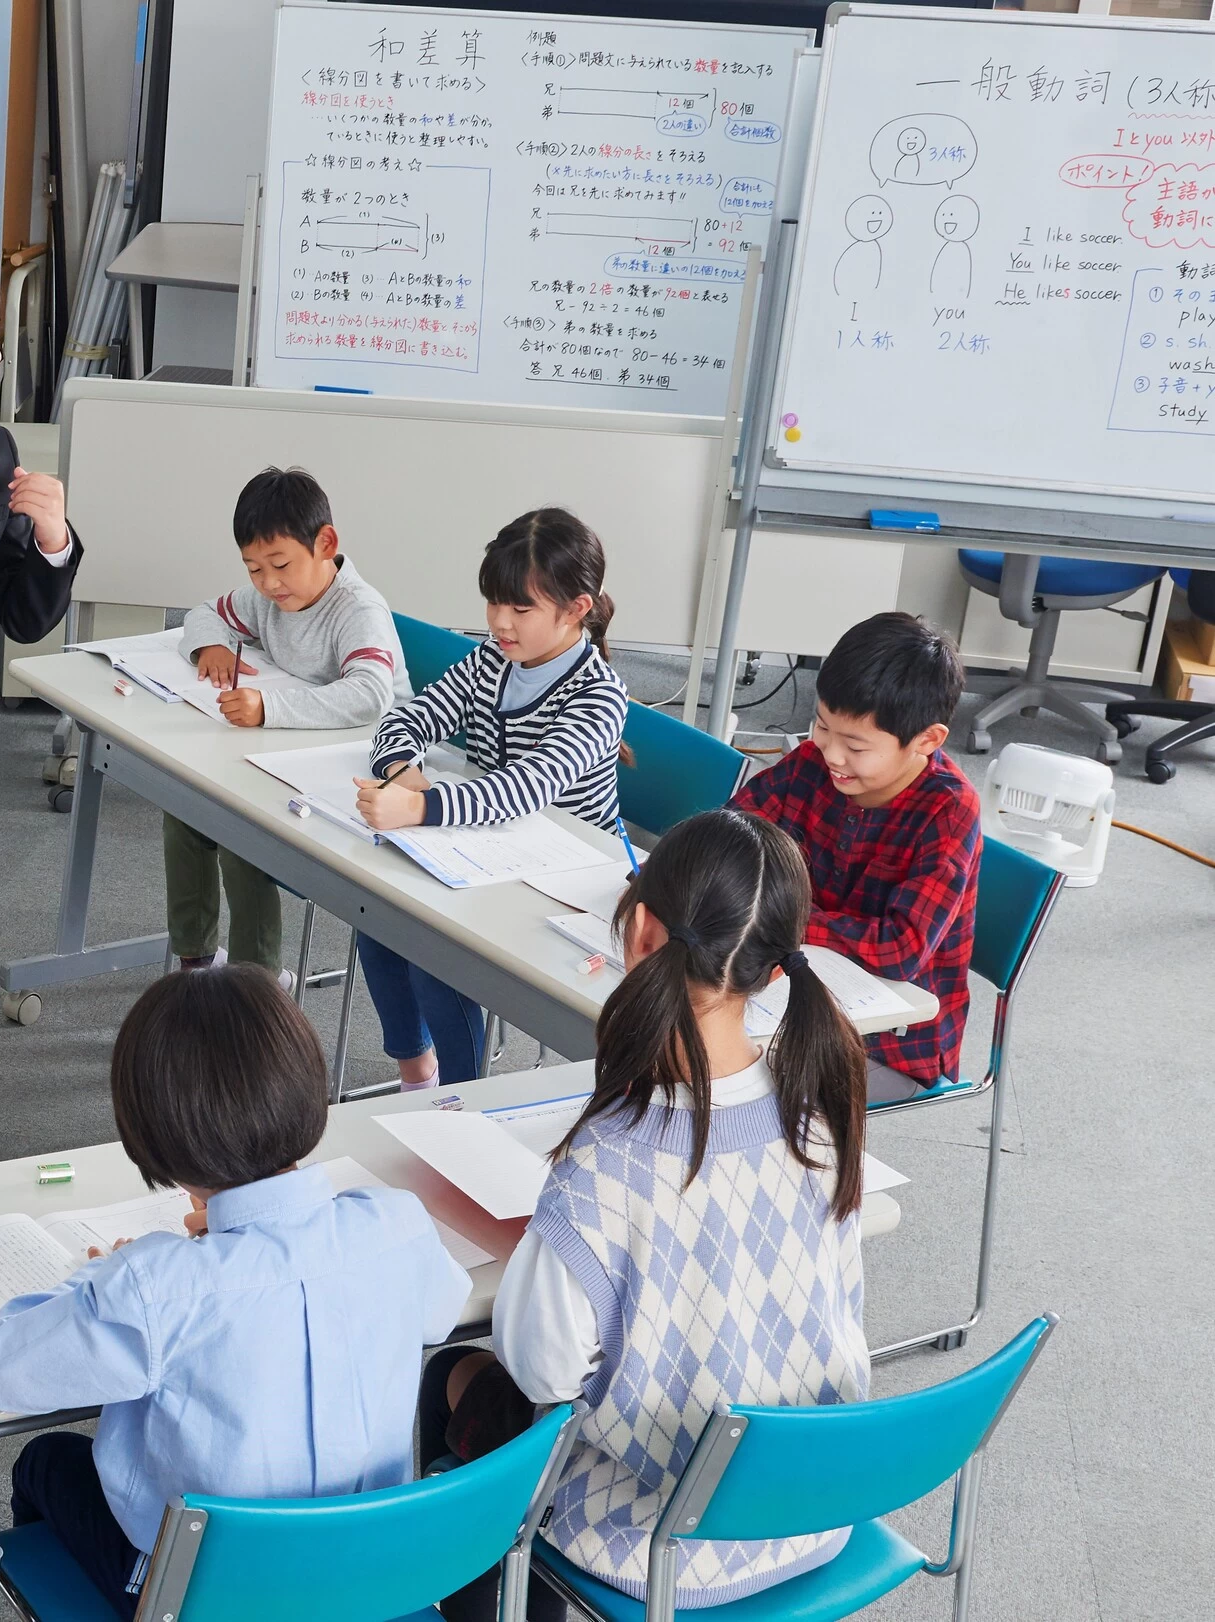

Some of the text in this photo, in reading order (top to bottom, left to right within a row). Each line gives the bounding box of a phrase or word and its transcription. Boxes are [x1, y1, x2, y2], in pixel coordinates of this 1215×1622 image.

[526, 29, 557, 45] 例題
[368, 27, 486, 70] 和差算
[544, 82, 557, 96] 兄
[301, 91, 394, 110] 線分図を使うとき
[541, 104, 554, 118] 弟
[928, 145, 968, 163] 3人称
[301, 188, 410, 207] 数量が2つのとき
[299, 215, 311, 228] A
[529, 207, 542, 219] 兄
[430, 233, 446, 244] (3)
[528, 227, 541, 241] 弟
[1022, 226, 1031, 242] I
[1046, 227, 1073, 242] like
[300, 239, 310, 253] B
[1009, 251, 1032, 271] You
[1042, 254, 1071, 271] like
[1003, 283, 1027, 300] He
[1035, 285, 1071, 301] likes
[848, 300, 859, 322] I
[932, 304, 966, 328] you
[836, 329, 895, 350] 1人称
[937, 330, 991, 356] 2人称
